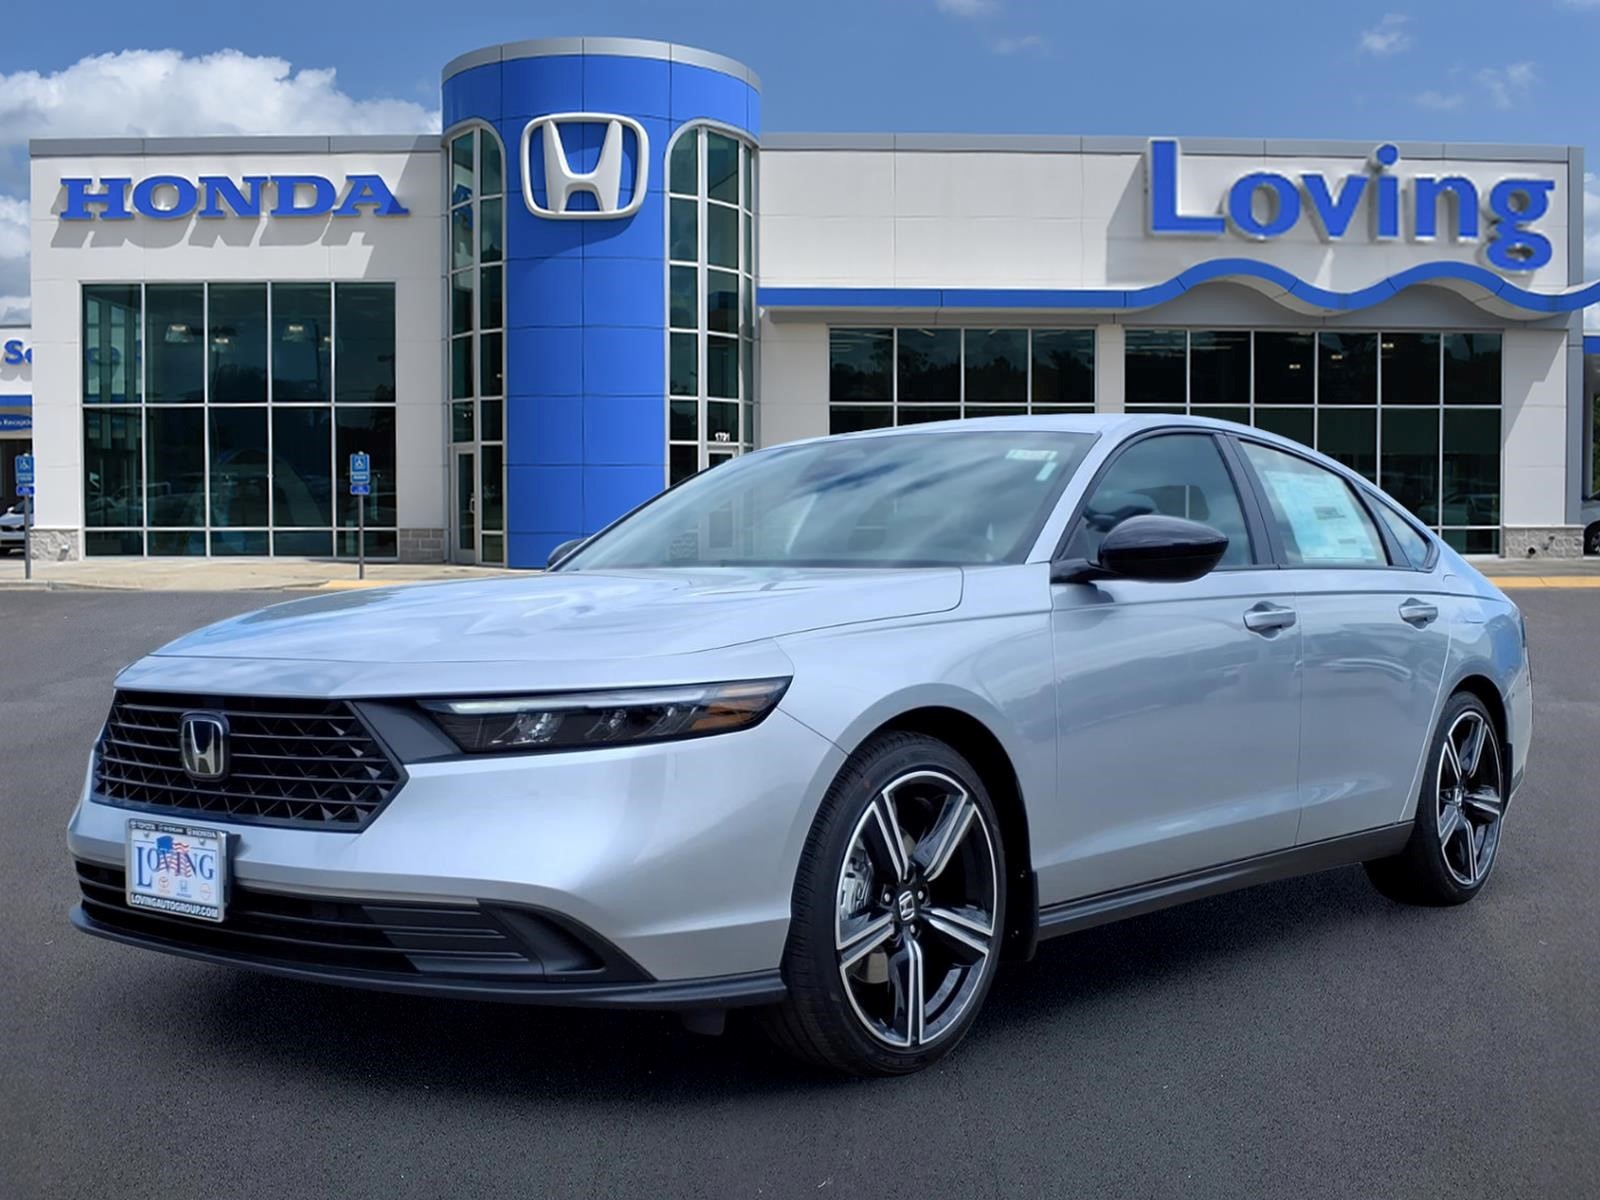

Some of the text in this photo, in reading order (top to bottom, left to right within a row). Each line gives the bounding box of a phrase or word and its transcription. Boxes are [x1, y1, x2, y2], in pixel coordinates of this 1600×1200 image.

[60, 174, 409, 220] HONDA
[1151, 139, 1556, 270] Loving
[136, 846, 214, 889] LOVING
[131, 894, 219, 918] LOVINGAUTOGROUP.COM
